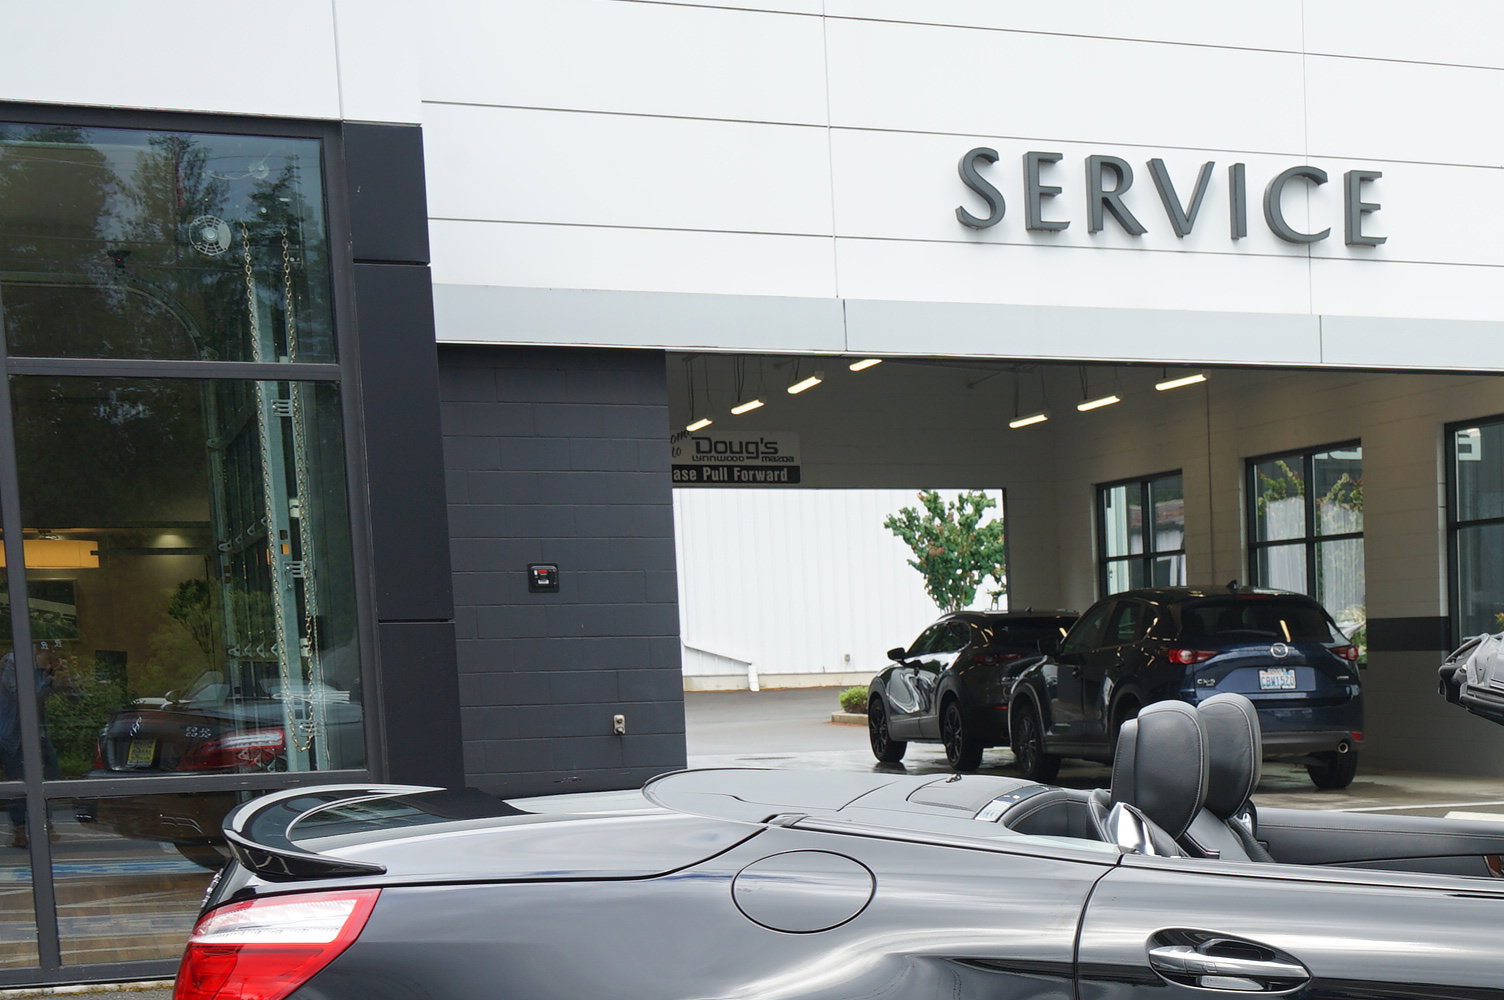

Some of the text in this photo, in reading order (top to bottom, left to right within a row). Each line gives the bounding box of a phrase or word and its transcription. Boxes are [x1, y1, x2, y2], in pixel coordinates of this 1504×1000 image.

[955, 146, 1388, 249] SERVICE
[691, 437, 779, 459] Doug's
[673, 467, 788, 481] ase Pull Forward
